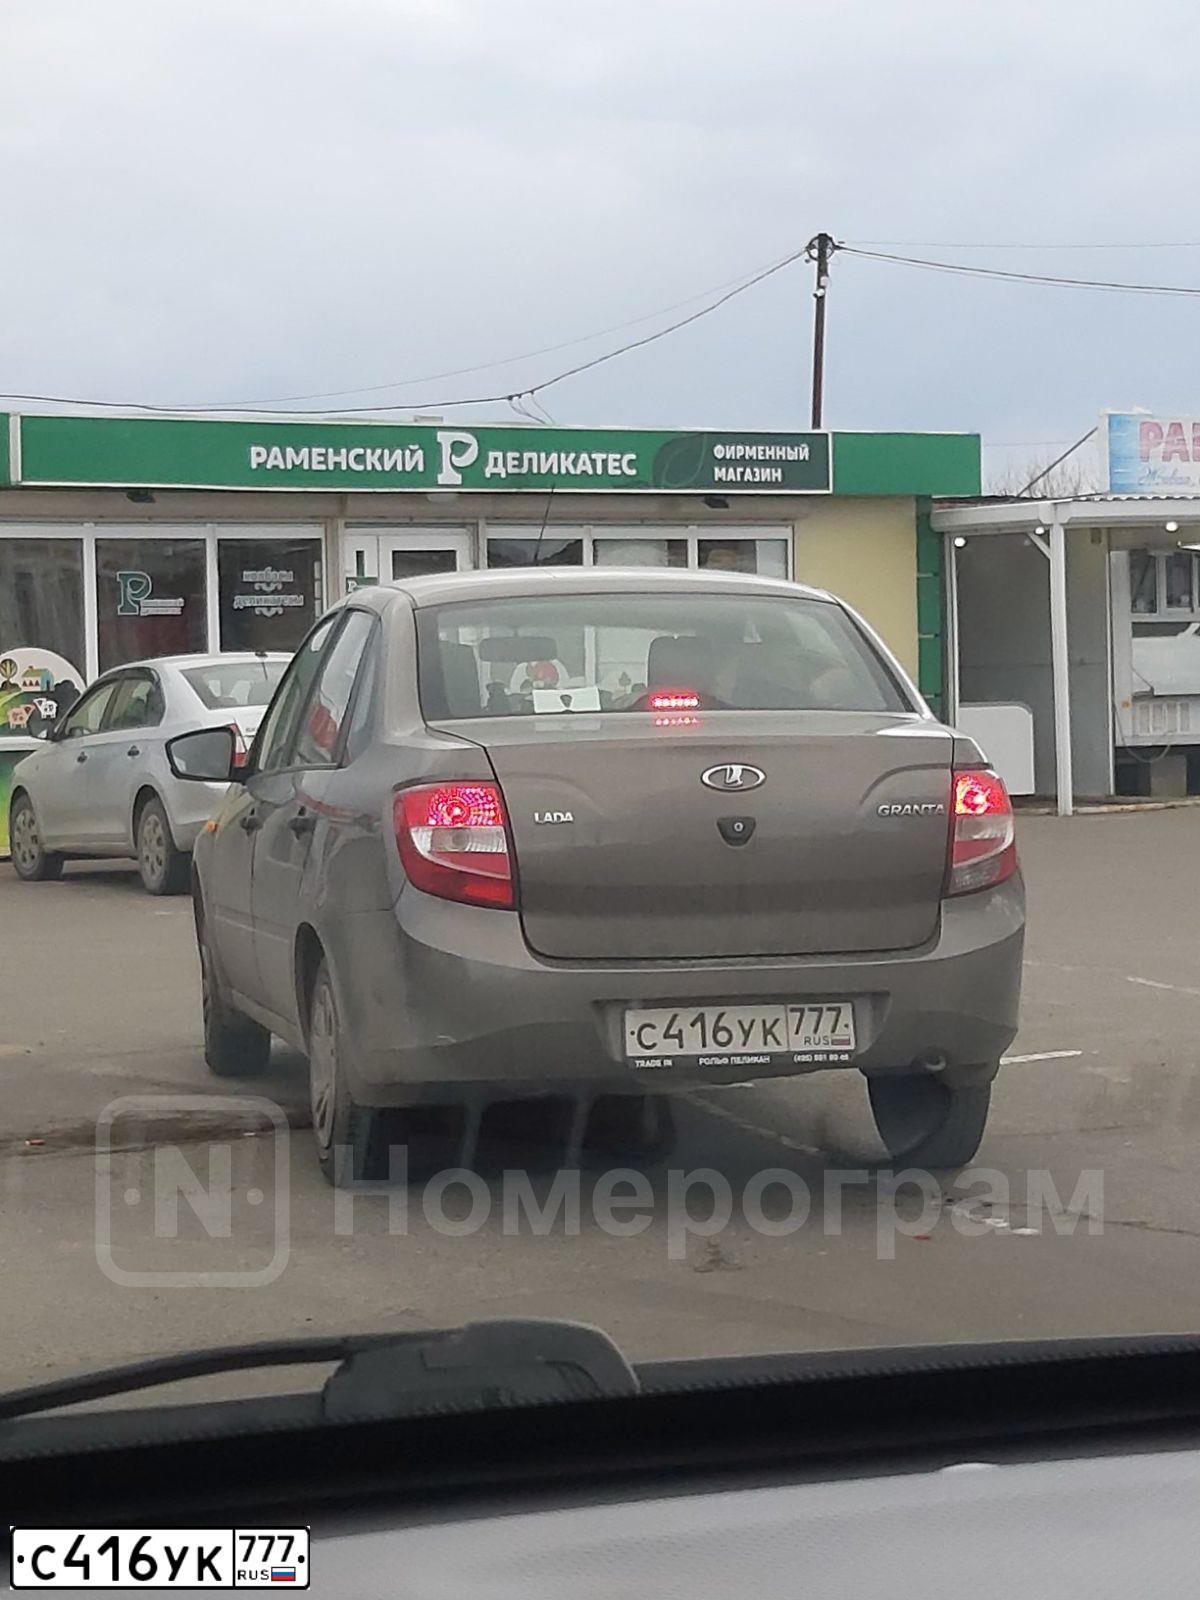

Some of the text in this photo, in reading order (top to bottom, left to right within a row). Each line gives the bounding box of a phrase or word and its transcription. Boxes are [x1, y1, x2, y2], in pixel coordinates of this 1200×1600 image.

[713, 443, 810, 461] ФИРМЕННЫЙ
[250, 445, 425, 472] РАМЕНСКИЙ
[485, 451, 637, 478] ДЕЛИКАТЕС
[713, 466, 783, 483] МАГАЗИН
[534, 812, 574, 823] LADA
[878, 804, 945, 816] GRANTA
[636, 1006, 842, 1050] С416УК 777
[803, 1035, 830, 1046] RUS
